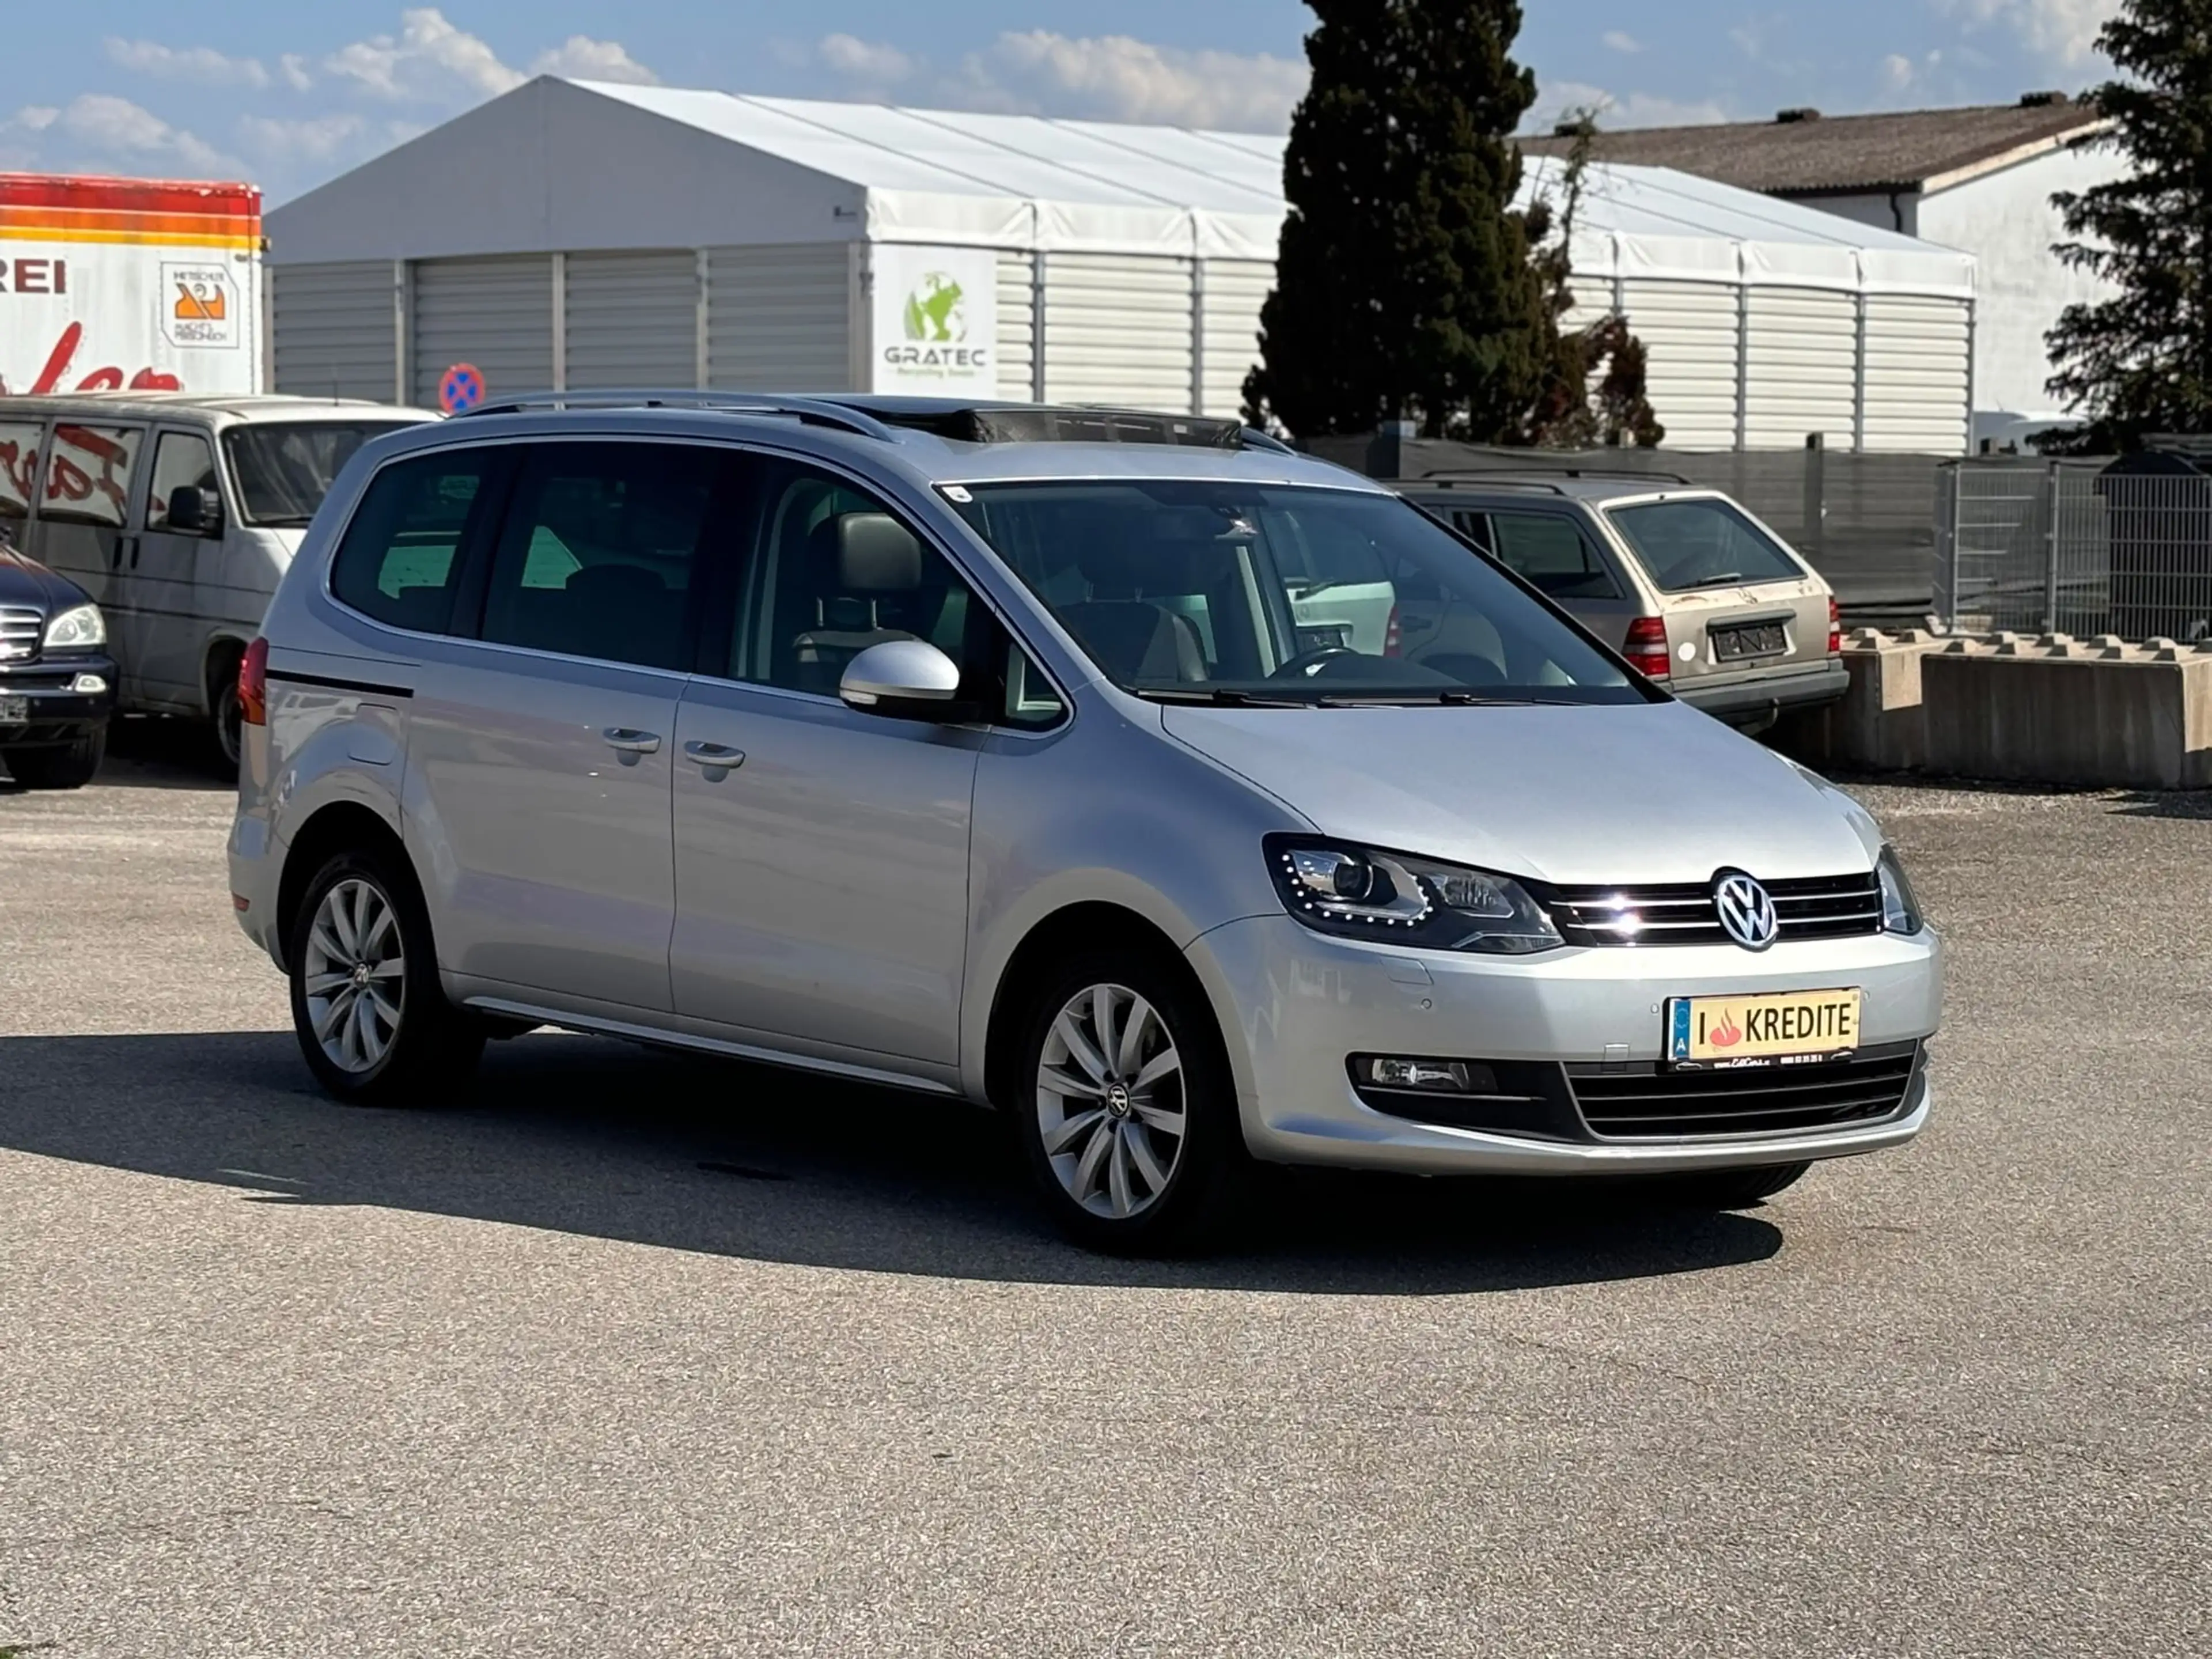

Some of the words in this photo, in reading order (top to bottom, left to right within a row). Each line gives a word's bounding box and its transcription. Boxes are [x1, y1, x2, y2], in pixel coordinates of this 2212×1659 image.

[0, 259, 66, 294] EI
[884, 346, 987, 366] GRATEC
[1699, 1012, 1705, 1044] I
[1746, 1003, 1851, 1042] KREDITE
[1676, 1037, 1686, 1051] A
